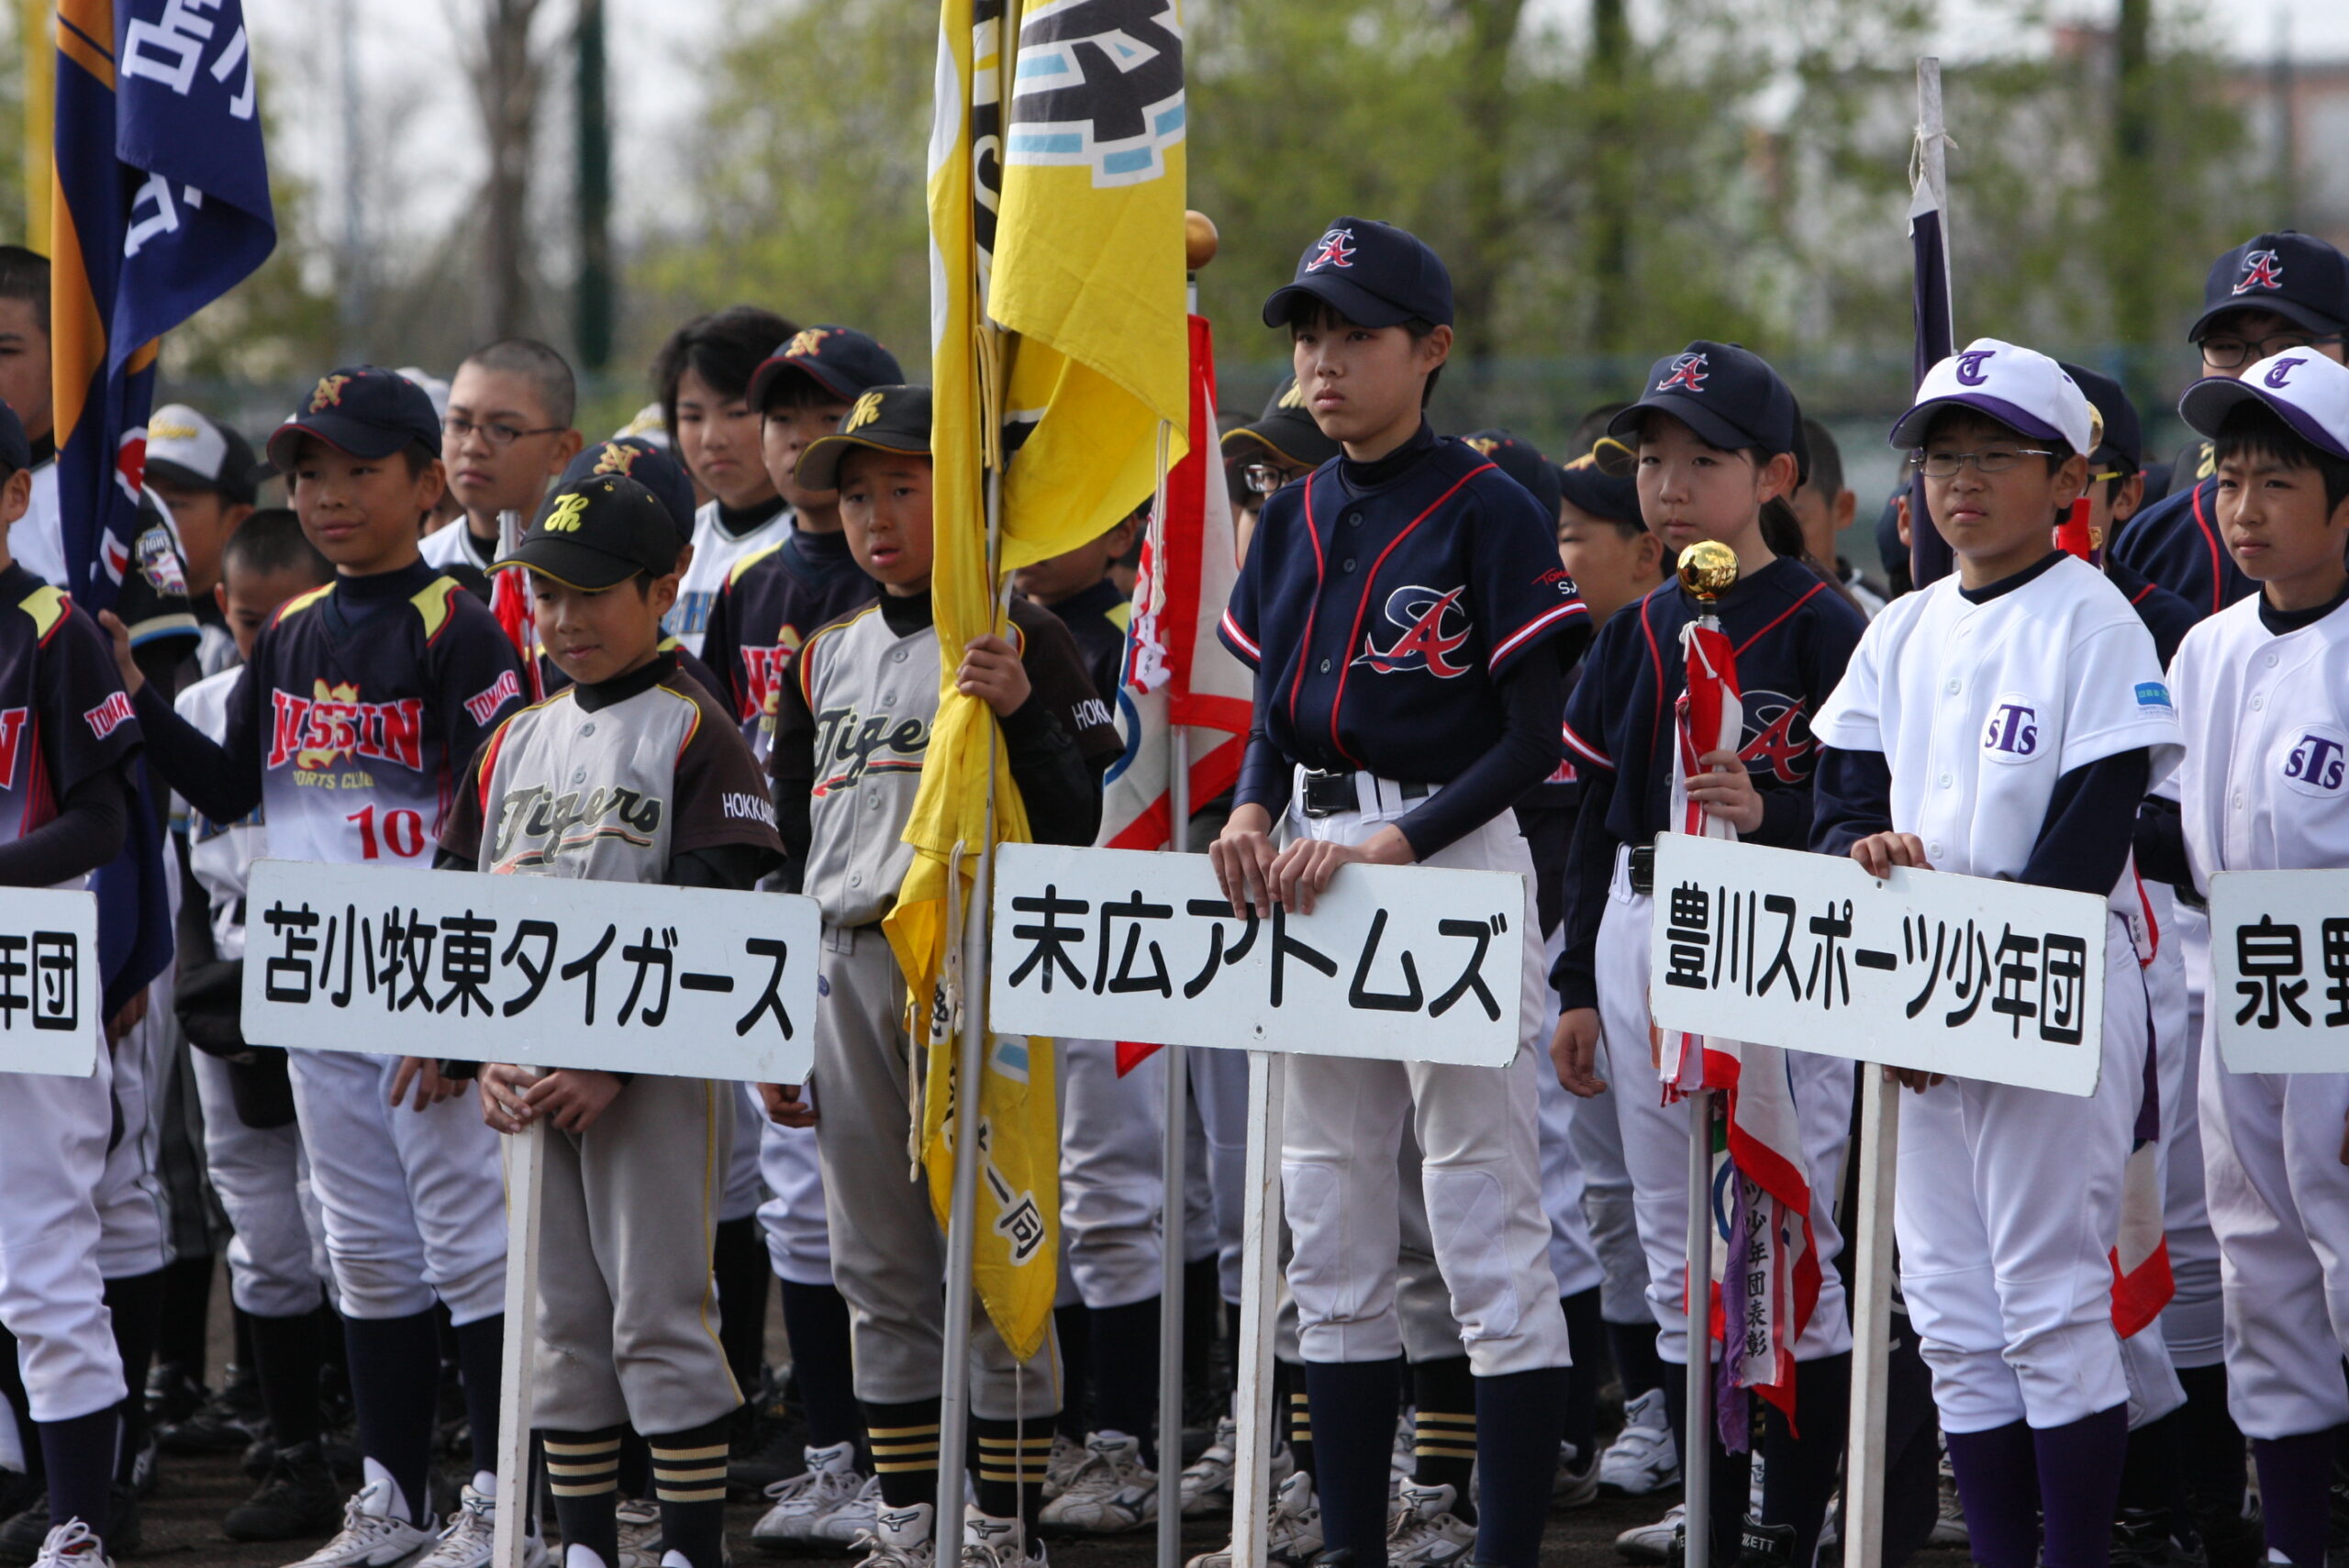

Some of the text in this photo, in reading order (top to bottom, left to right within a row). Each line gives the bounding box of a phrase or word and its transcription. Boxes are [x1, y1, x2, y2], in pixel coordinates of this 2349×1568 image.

[346, 802, 426, 861] 10
[263, 900, 794, 1041] 苫小牧東タイガース
[1008, 884, 1508, 1022] 末広アトムズ
[1665, 881, 2087, 1046] 豊川スポーツ少年団
